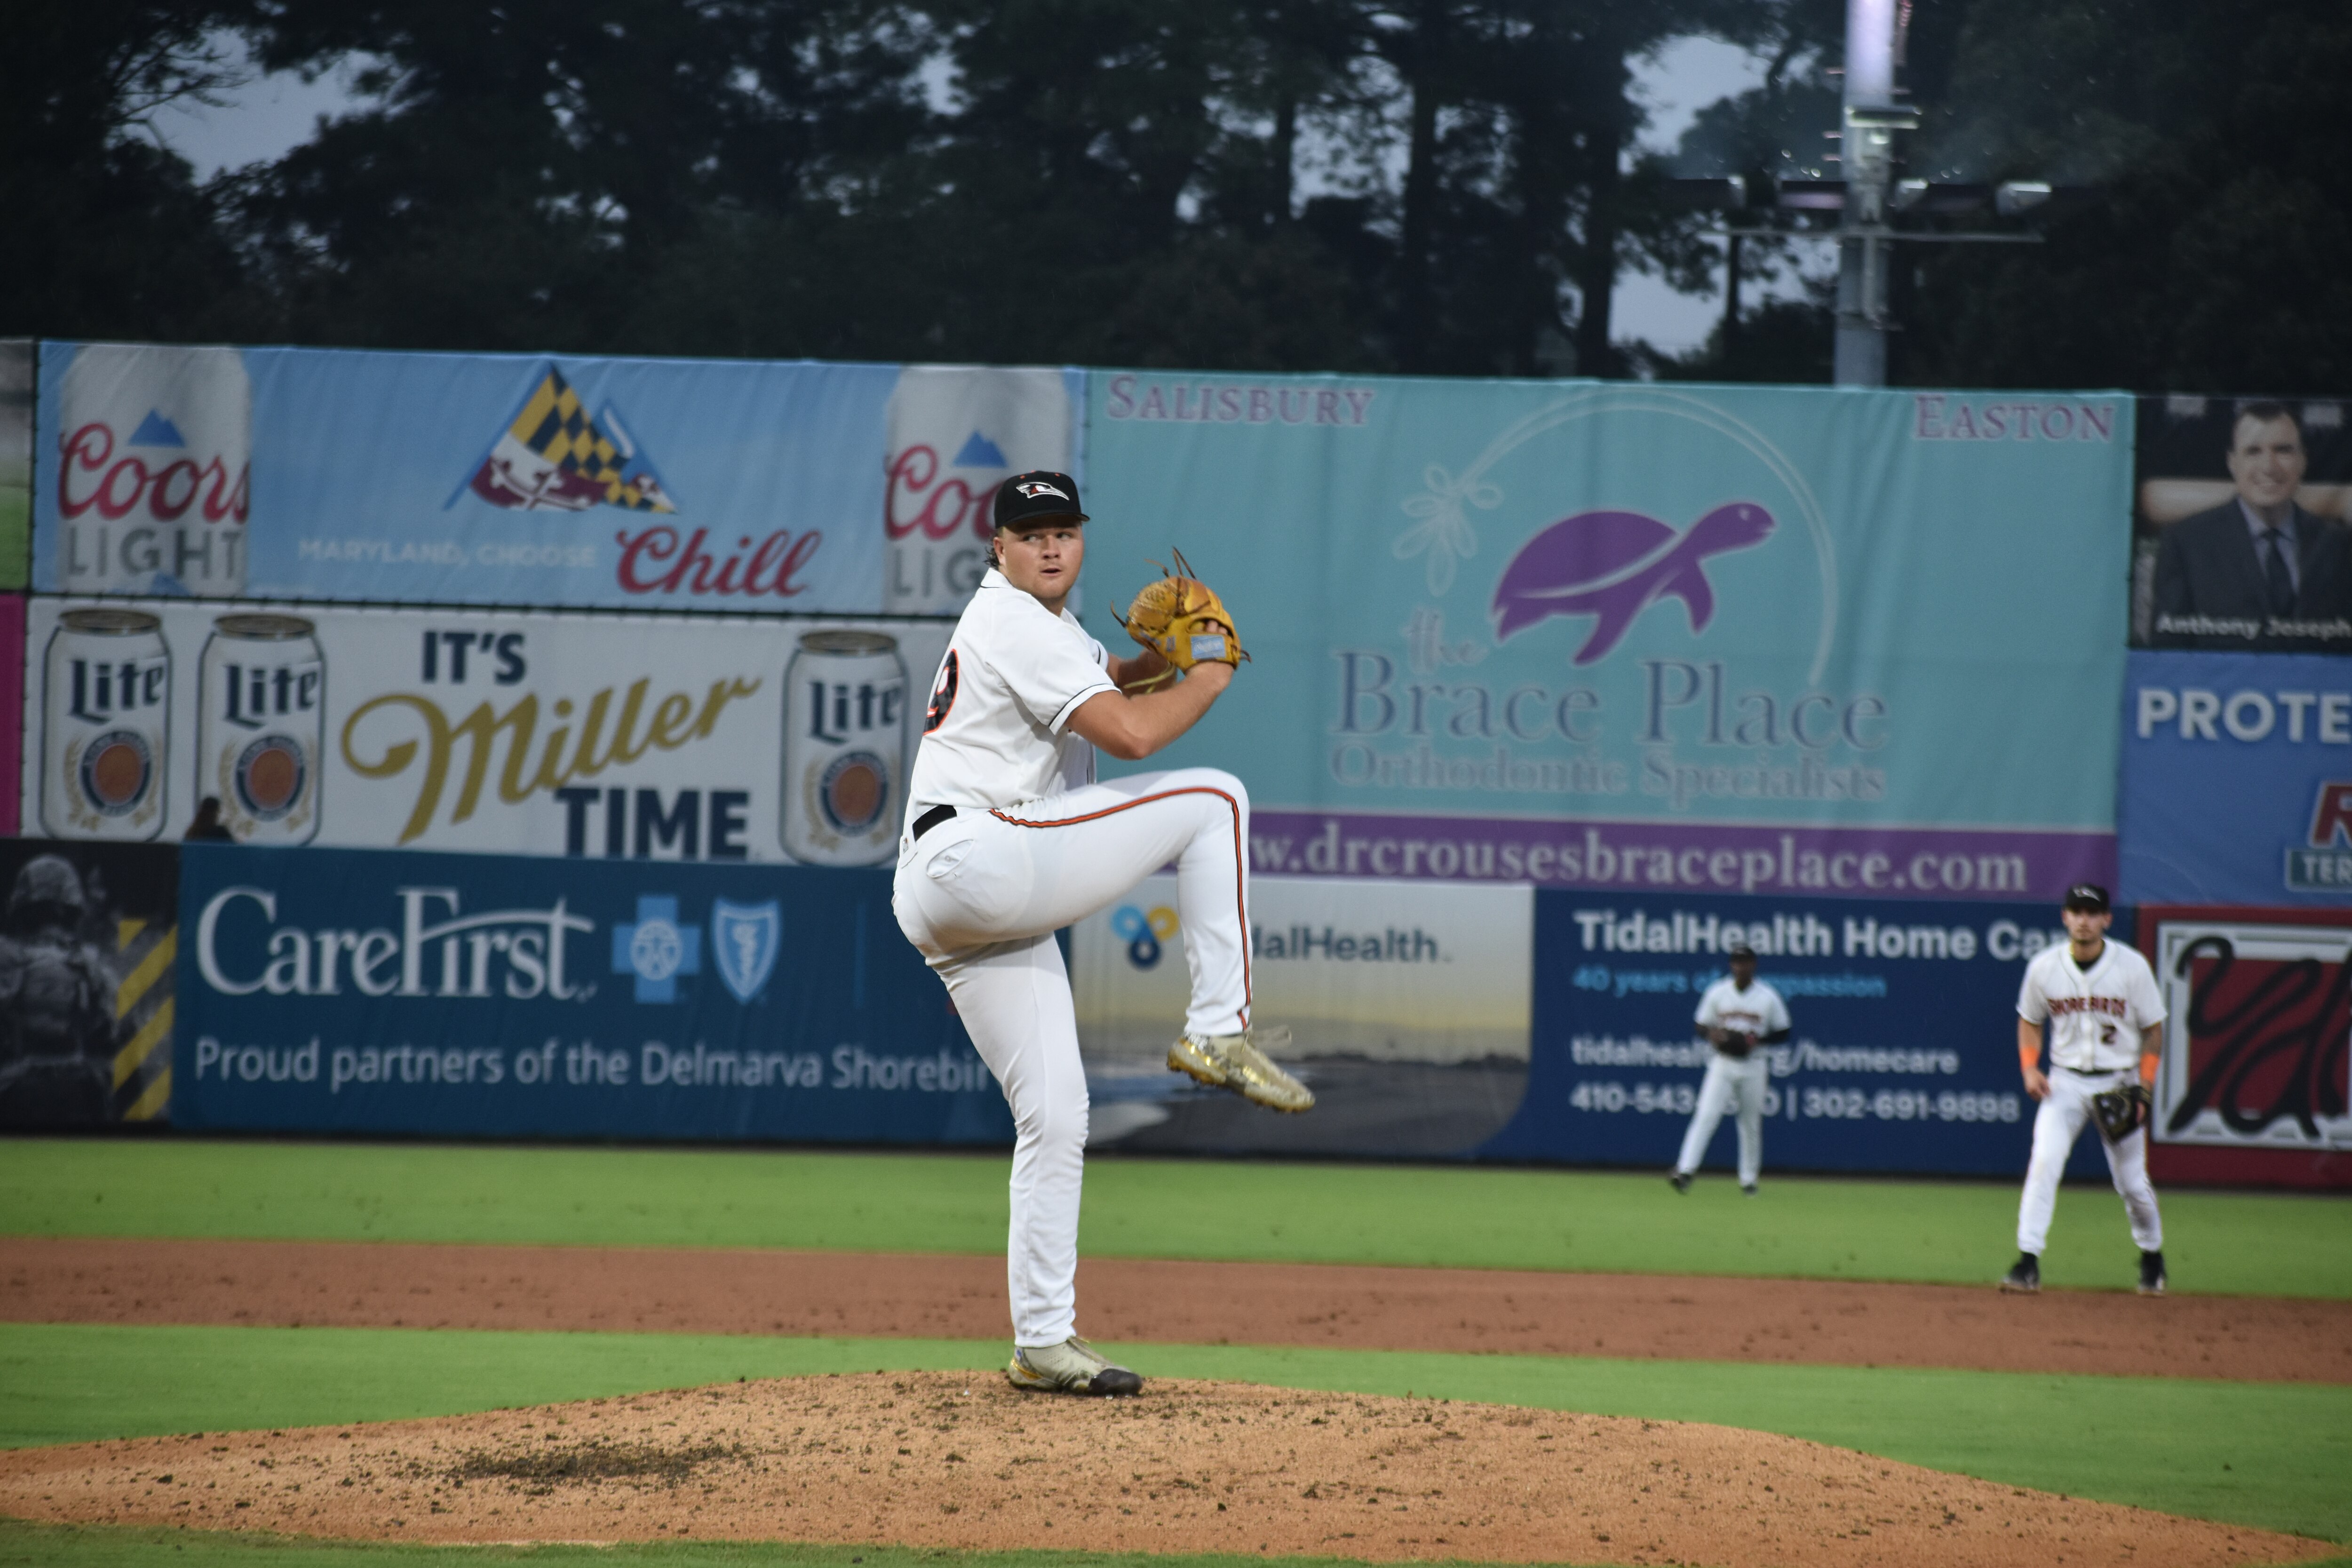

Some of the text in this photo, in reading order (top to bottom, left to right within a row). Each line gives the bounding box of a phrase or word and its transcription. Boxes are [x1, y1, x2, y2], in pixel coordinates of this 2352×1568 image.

[1107, 374, 1375, 425] SALISBURY
[1915, 394, 2114, 443] EASTON
[69, 526, 242, 581] LIGHT
[476, 545, 596, 567] CHOOSE
[615, 525, 823, 597] Chill
[894, 547, 984, 598] LIG
[2156, 614, 2260, 641] Anthony
[421, 630, 527, 685] IT'S
[70, 658, 165, 725] Lite
[224, 663, 318, 730] Lite
[809, 680, 901, 746] Lite
[1329, 650, 1886, 749] Brace Place
[2137, 688, 2352, 744] PROTE
[341, 676, 763, 846] Miller
[556, 787, 748, 861] TIME
[1249, 820, 2028, 894] w.drcrousesbraceplace.com
[2304, 854, 2352, 885] TER
[1573, 910, 1834, 957] TidalHealth
[1843, 916, 1977, 961] Home
[195, 1036, 989, 1094] Proud partners of the Delmarva Shorebir
[1803, 1087, 2020, 1123] 302-691-9898
